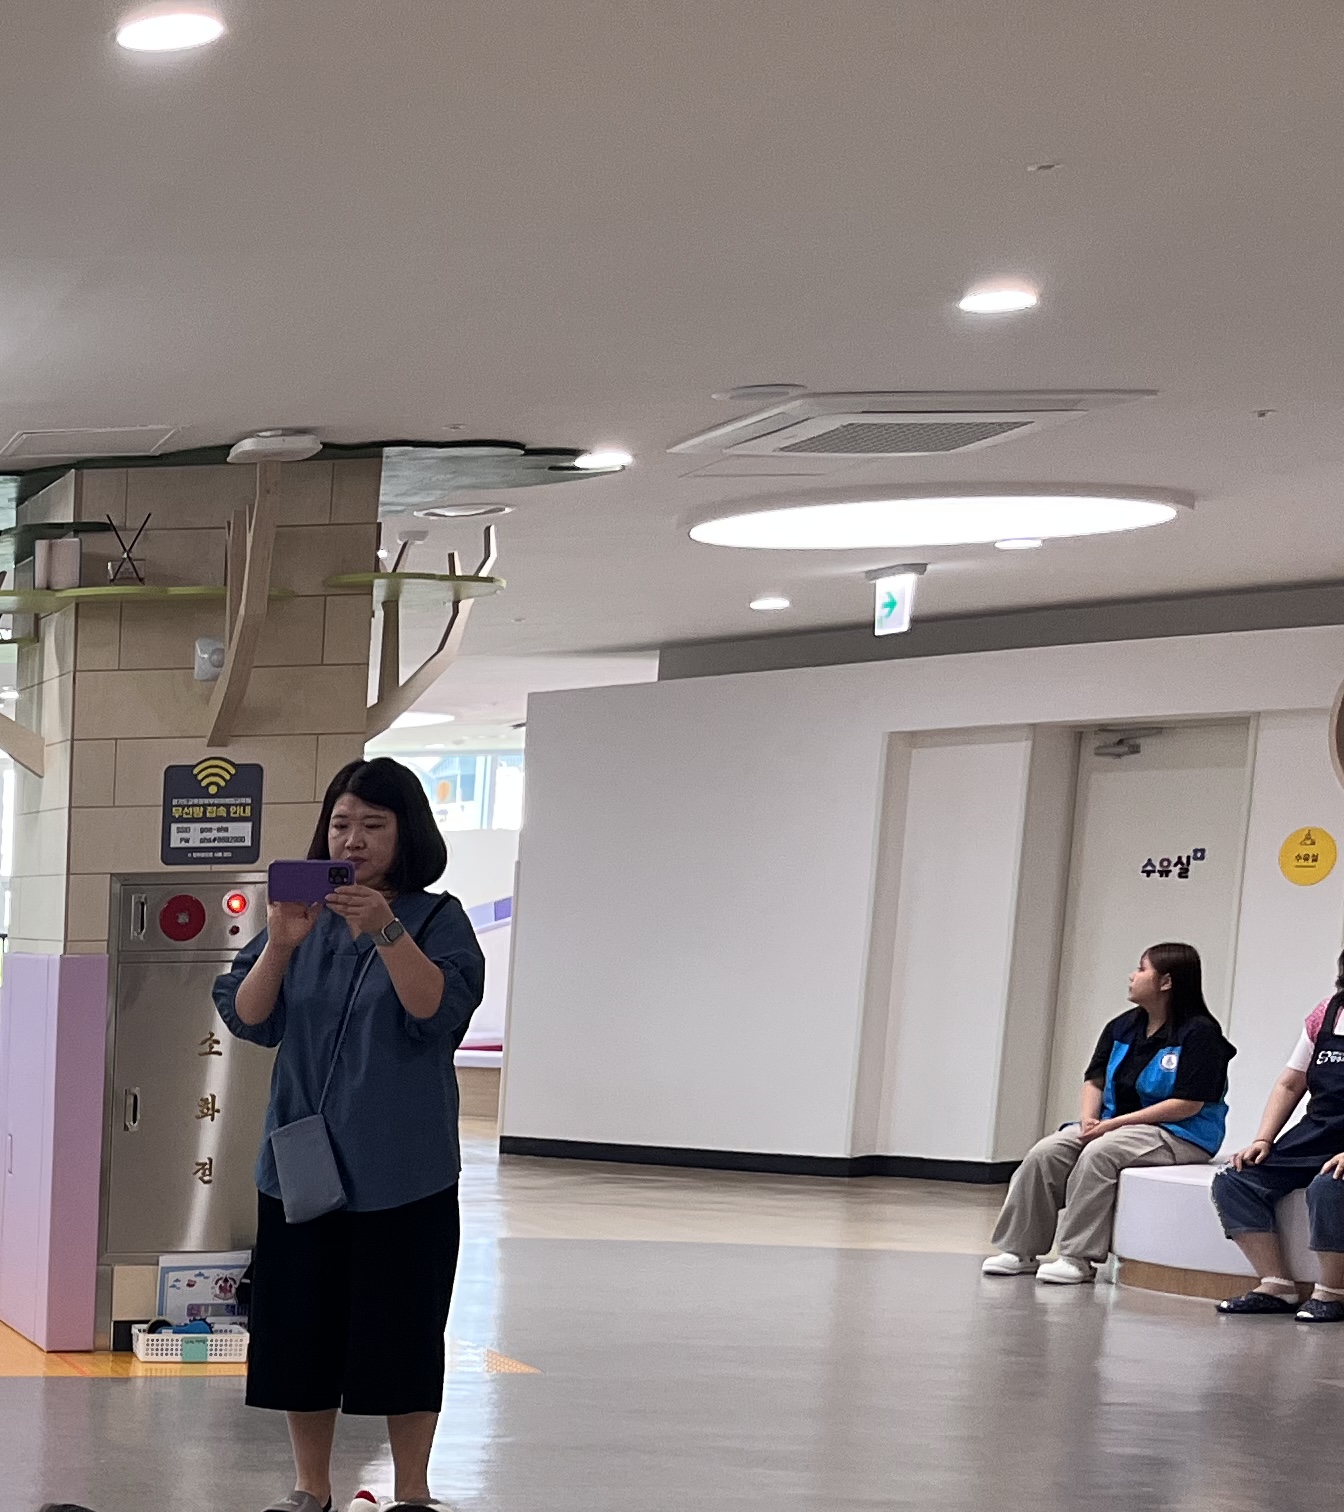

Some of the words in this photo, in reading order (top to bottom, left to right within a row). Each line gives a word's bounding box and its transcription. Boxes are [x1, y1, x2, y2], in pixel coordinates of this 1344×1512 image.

[172, 806, 204, 818] 무선망
[206, 806, 227, 818] 접속
[230, 806, 251, 818] 안내
[1141, 855, 1191, 879] 수유실
[1294, 853, 1320, 863] 수유실
[192, 1030, 223, 1186] 소화전
